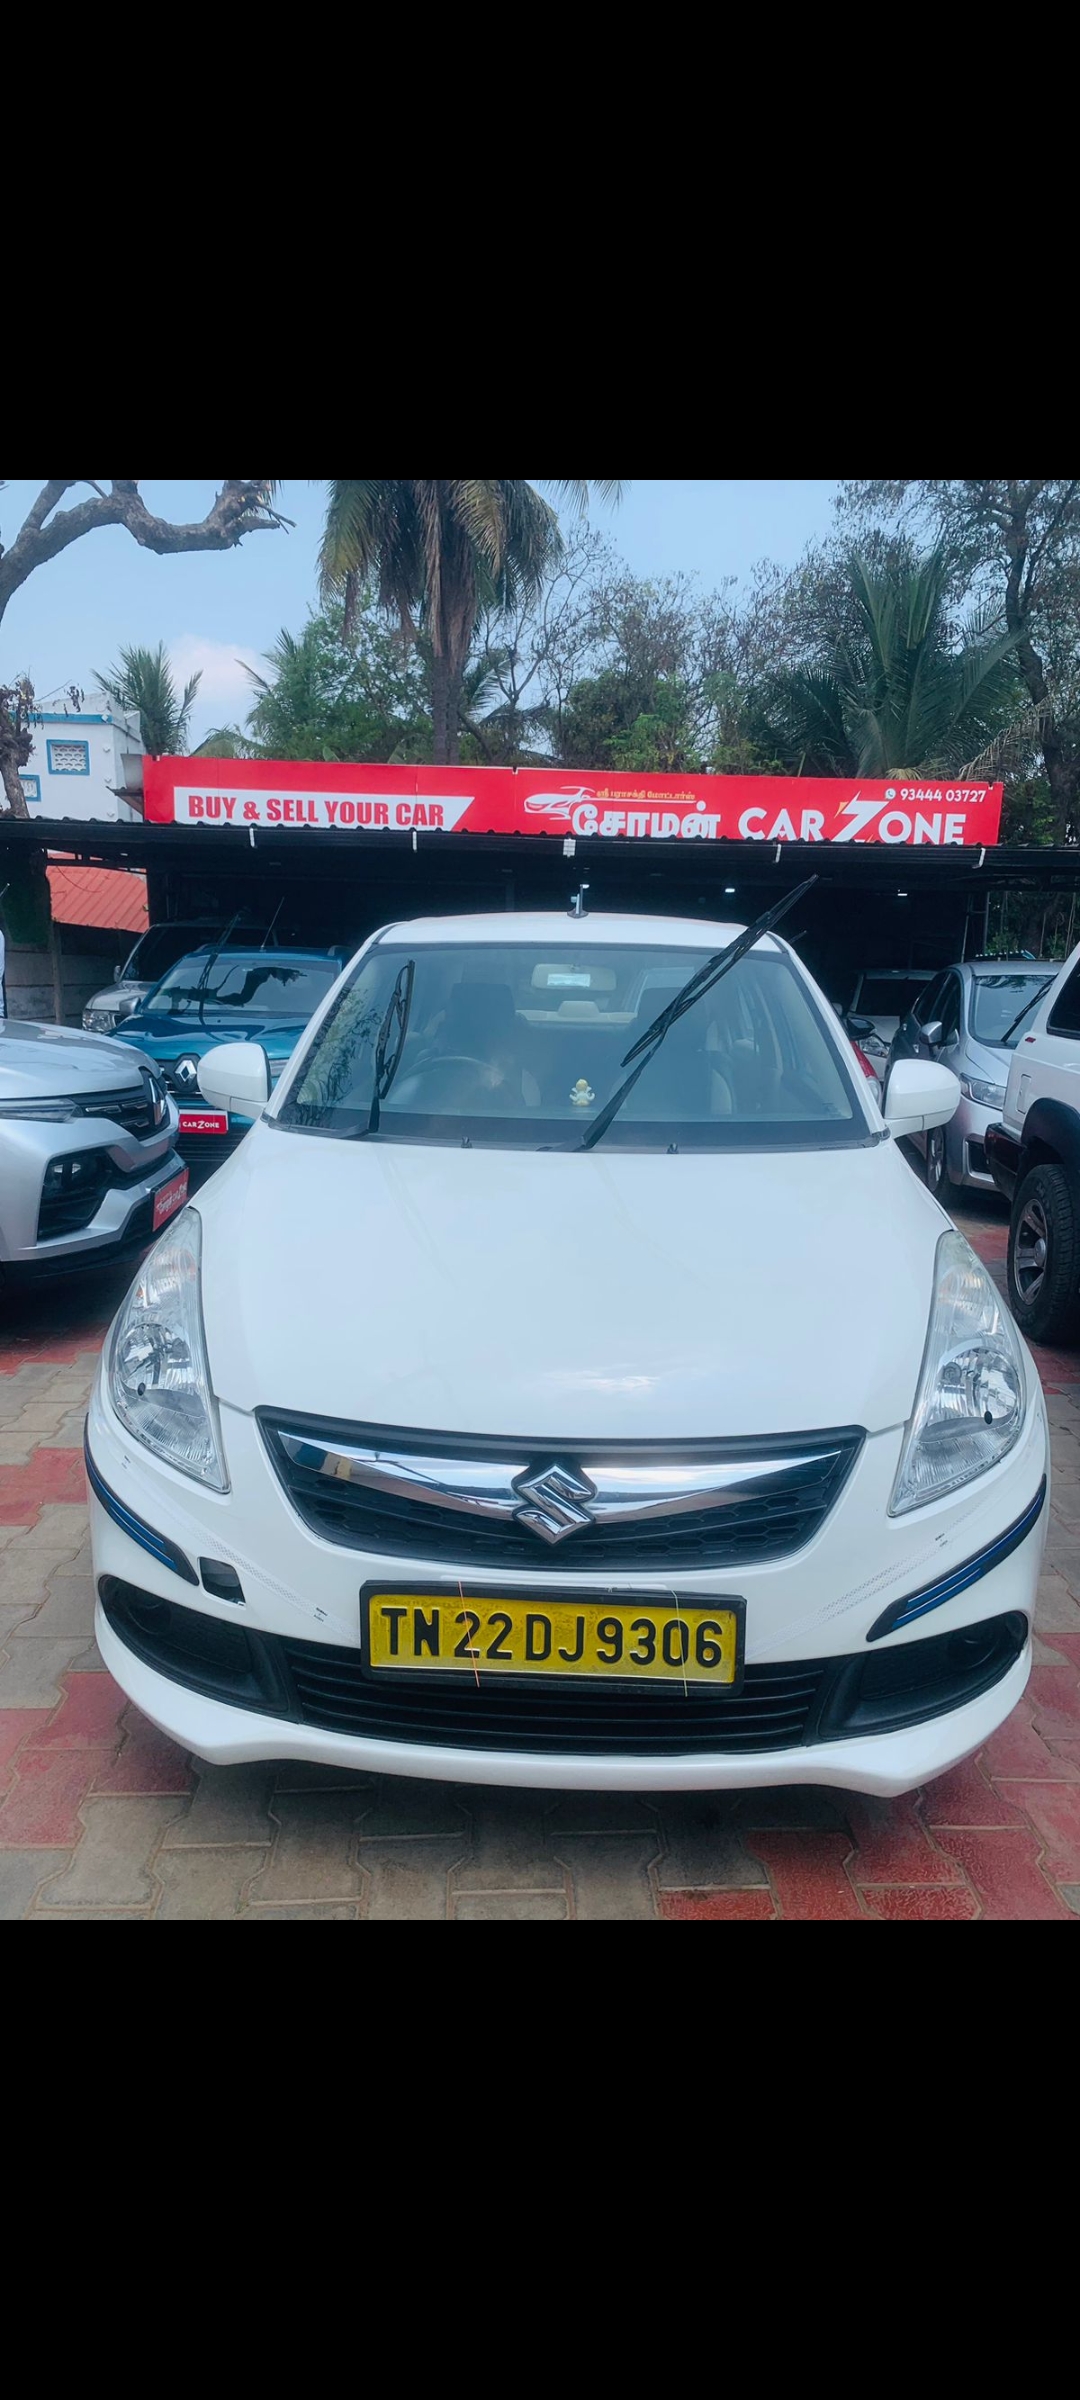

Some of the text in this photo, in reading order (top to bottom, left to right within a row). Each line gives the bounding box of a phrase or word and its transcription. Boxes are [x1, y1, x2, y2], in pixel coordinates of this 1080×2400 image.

[188, 795, 444, 827] BUY & SELL YOUR CAR
[900, 788, 986, 802] 93444 03727
[572, 800, 721, 839] சோமன்
[738, 807, 825, 842] CAR
